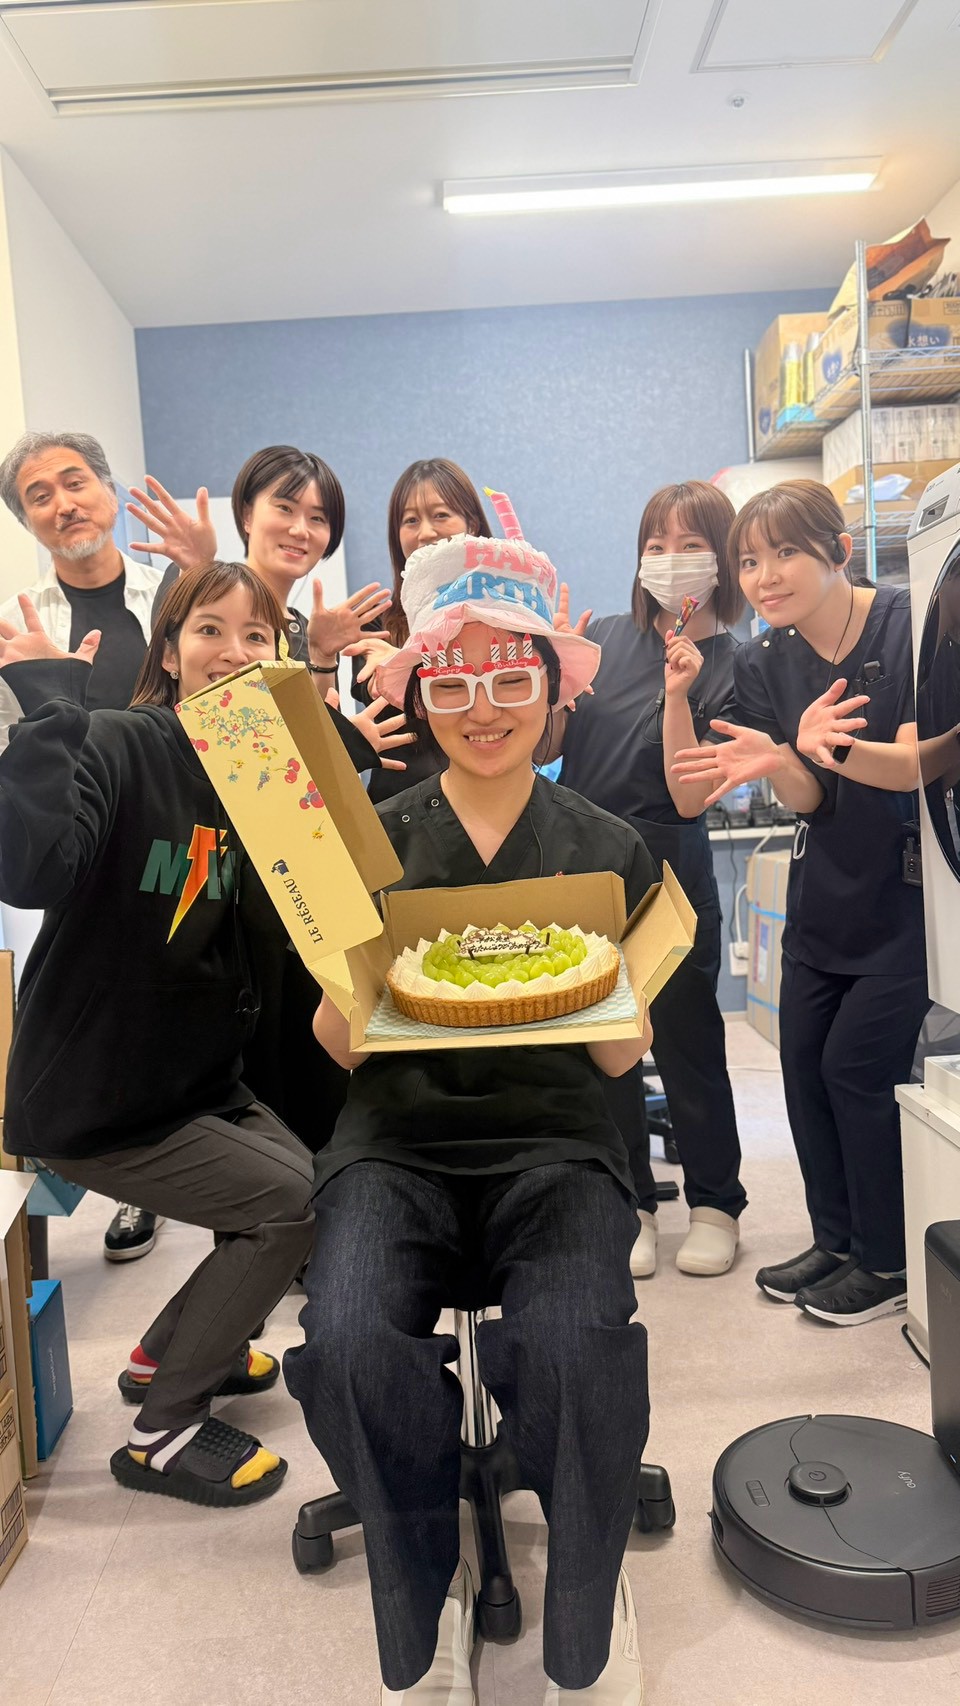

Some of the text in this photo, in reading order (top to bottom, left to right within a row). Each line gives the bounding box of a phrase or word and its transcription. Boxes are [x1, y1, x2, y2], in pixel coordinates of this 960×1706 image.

[433, 659, 529, 675] Happy Birthday
[283, 878, 324, 944] LE RÉSEAU
[897, 1471, 916, 1488] eufy
